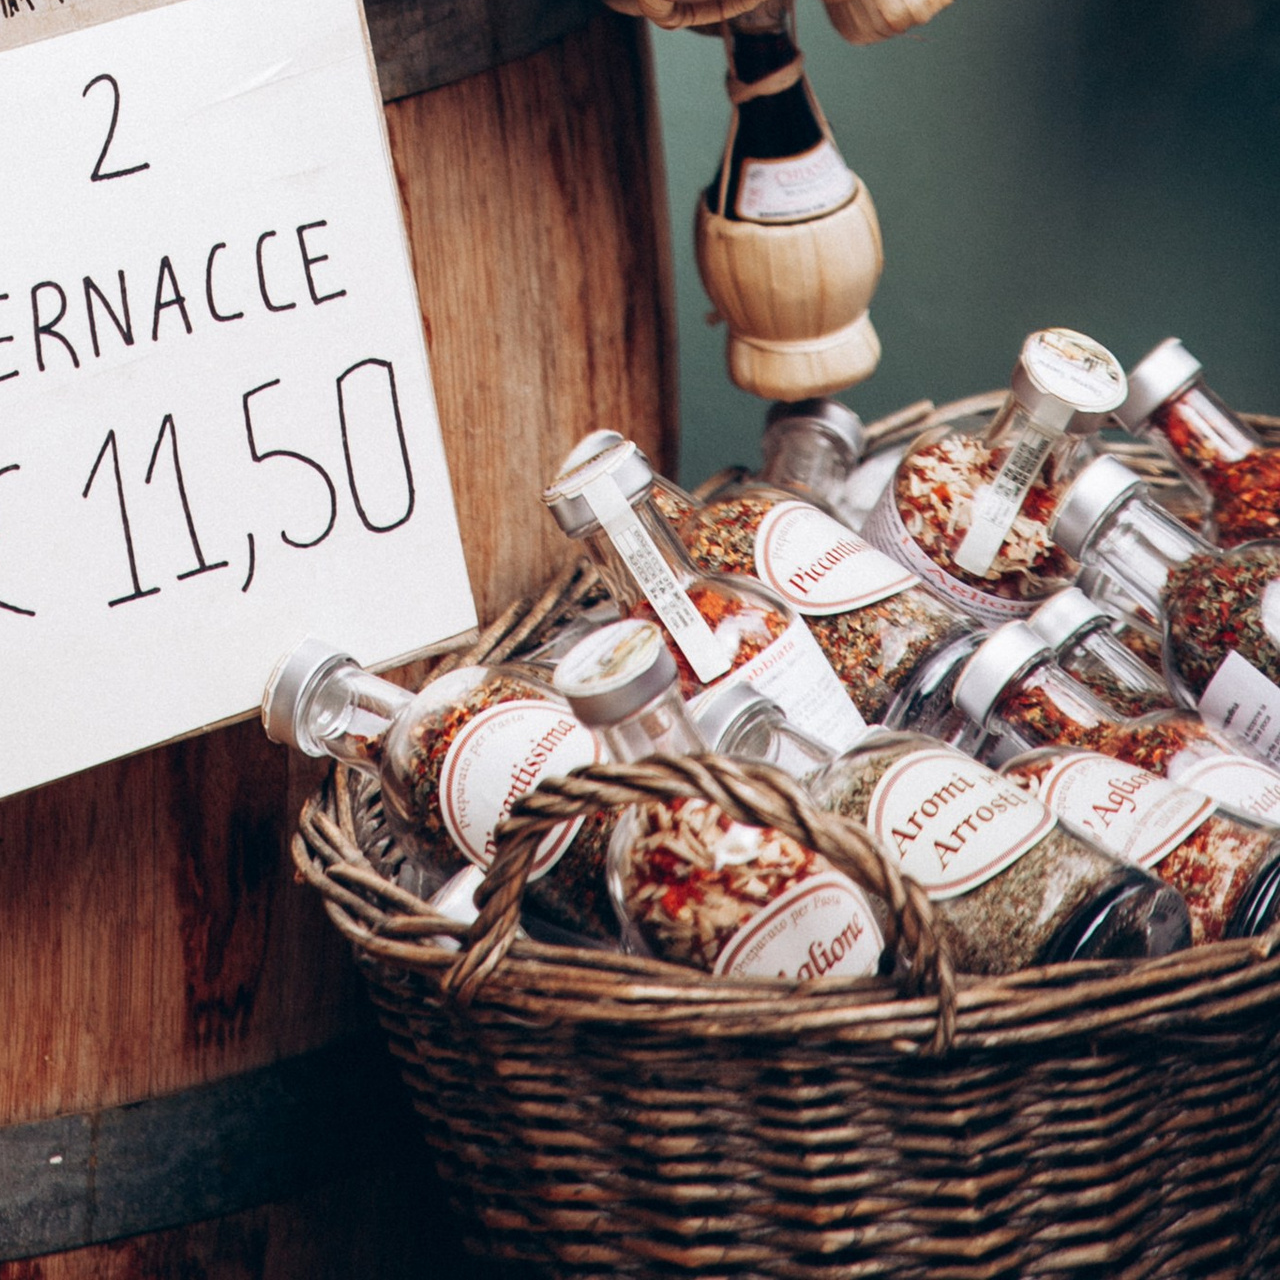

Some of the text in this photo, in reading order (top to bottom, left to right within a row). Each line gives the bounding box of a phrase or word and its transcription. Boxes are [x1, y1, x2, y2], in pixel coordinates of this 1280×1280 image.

[83, 74, 150, 183] 2
[81, 356, 417, 609] 11,50
[891, 772, 976, 861] Aromi
[933, 787, 1029, 873] Arrosti
